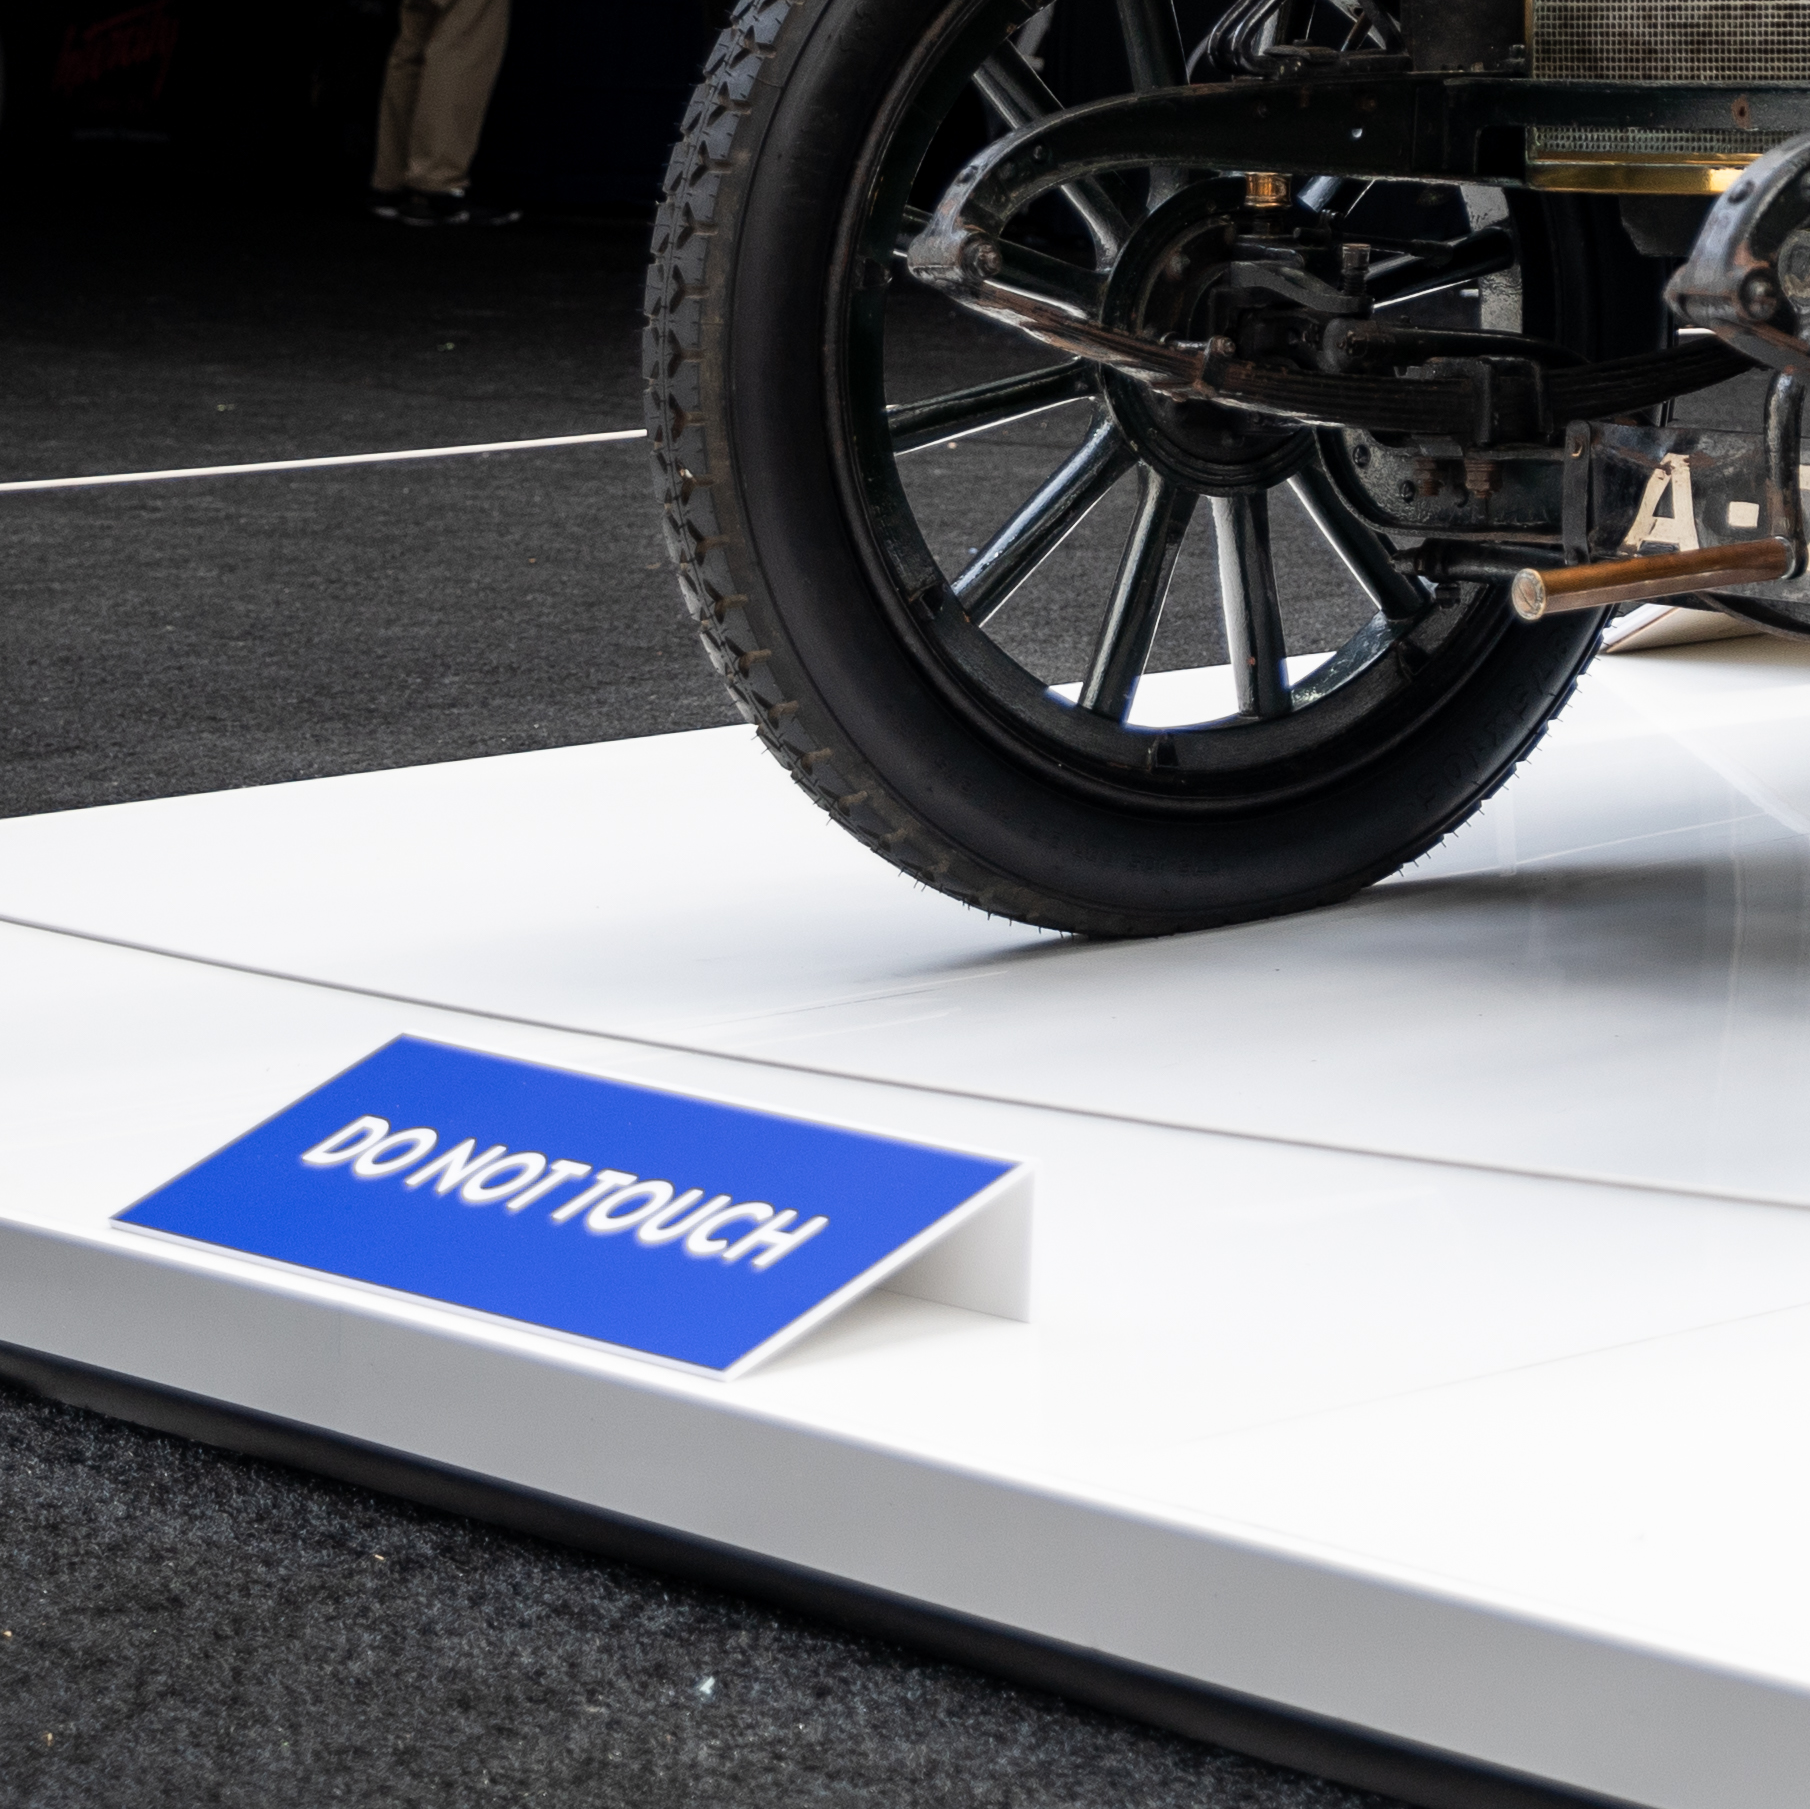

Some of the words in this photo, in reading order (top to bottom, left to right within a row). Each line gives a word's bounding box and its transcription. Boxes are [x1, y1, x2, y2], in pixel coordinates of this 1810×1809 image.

[301, 1114, 438, 1178] DO
[404, 1137, 592, 1211] NOT
[550, 1168, 830, 1269] TOUCH
